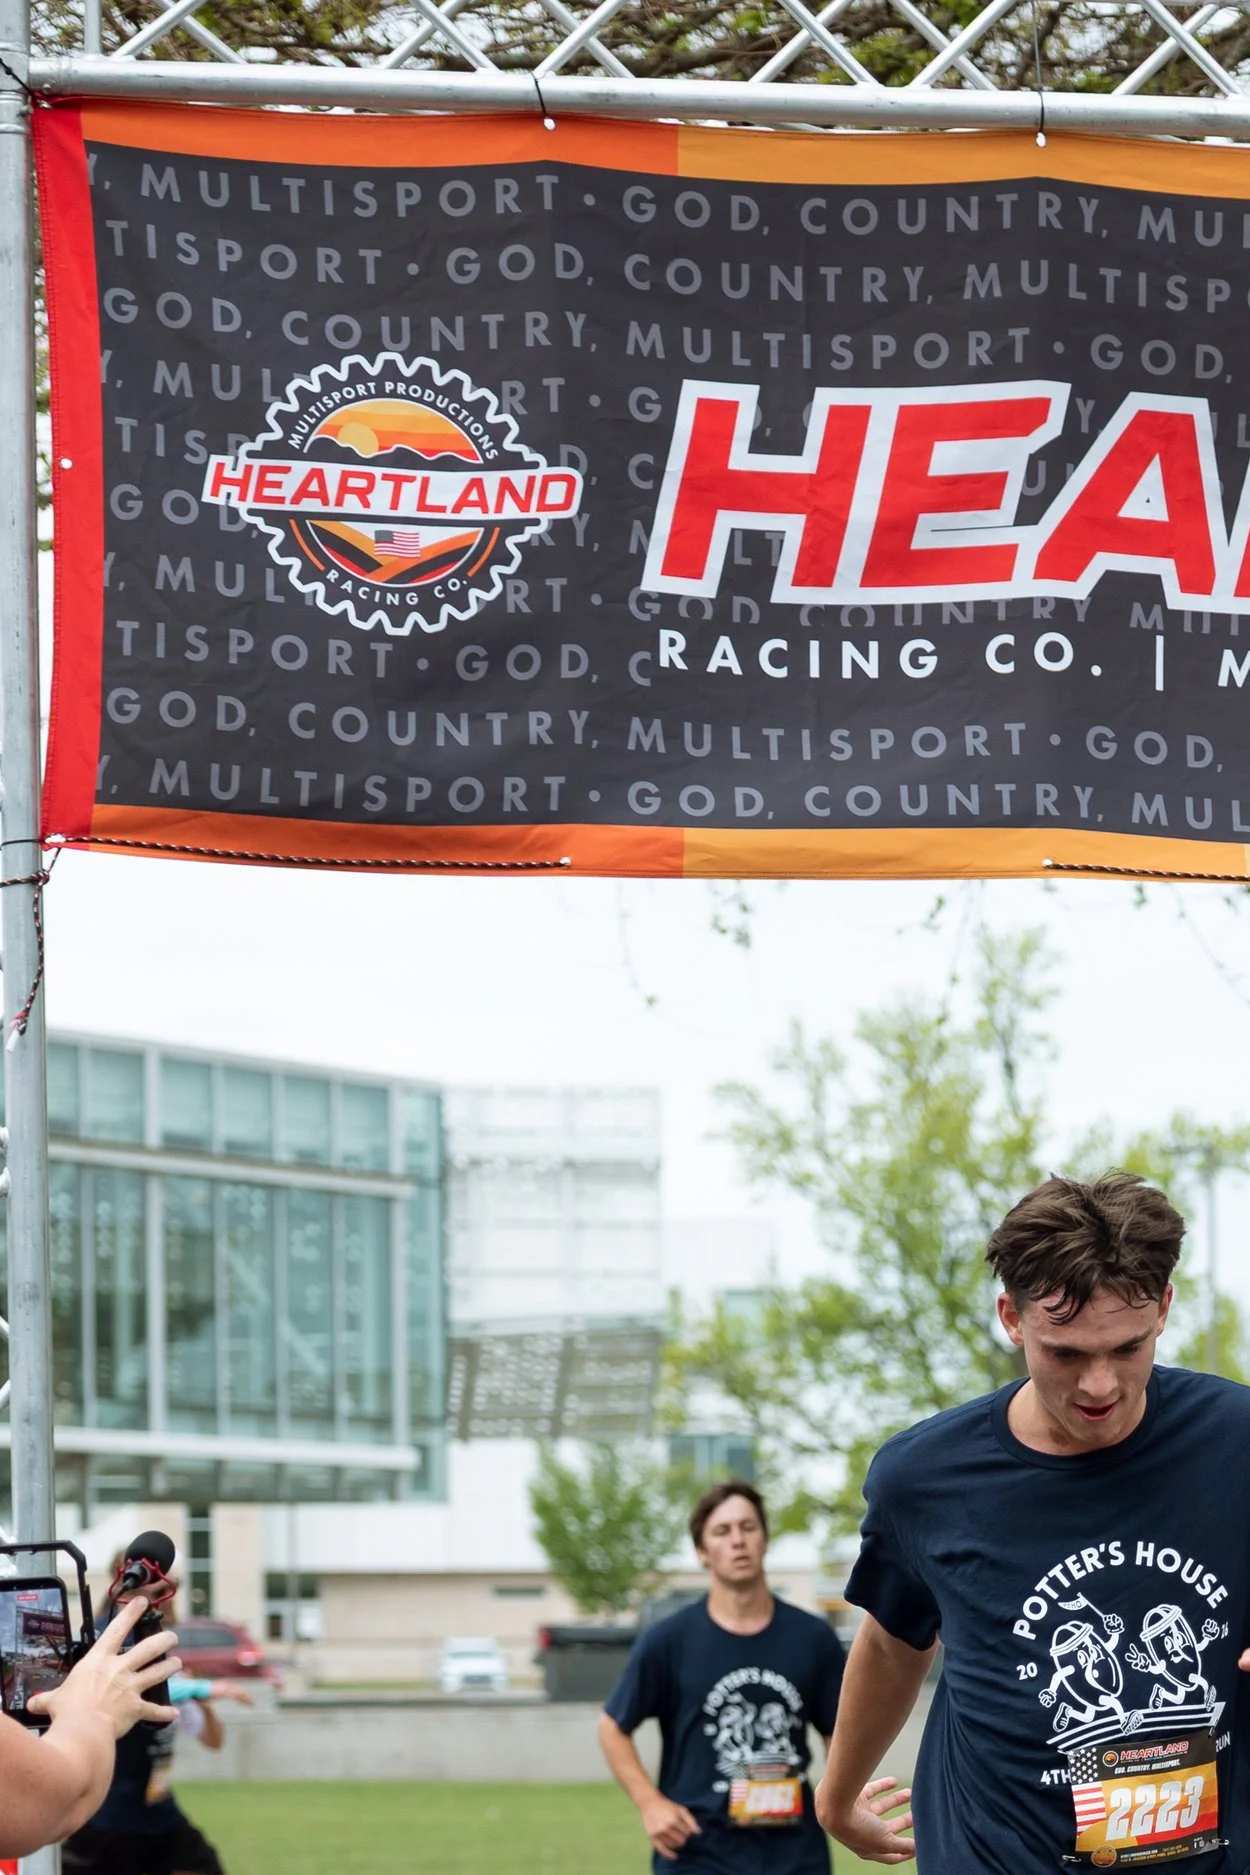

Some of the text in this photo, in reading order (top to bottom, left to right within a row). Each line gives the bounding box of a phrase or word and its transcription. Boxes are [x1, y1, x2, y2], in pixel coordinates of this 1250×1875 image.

[141, 164, 559, 217] MULTISPORT
[623, 186, 769, 235] GOD,
[800, 192, 1107, 239] COUNTRY,
[446, 243, 593, 286] GOD,
[624, 254, 933, 304] COUNTRY,
[104, 288, 252, 339] GOD,
[282, 311, 596, 352] COUNTRY,
[626, 321, 1030, 370] MULTISPORT
[1091, 334, 1231, 384] GOD,
[287, 381, 499, 460] MULTISPORT PRODUCTIONS
[207, 459, 579, 517] HEARTLAND
[326, 569, 467, 606] RACING CO.
[456, 644, 598, 683] GOD,
[658, 629, 938, 678] RACING
[985, 632, 1102, 676] CO.
[106, 687, 255, 736] GOD,
[289, 702, 598, 749] COUNTRY,
[627, 717, 1026, 761] MULTISPORT
[1086, 726, 1224, 773] GOD,
[149, 758, 566, 812] MULTISPORT
[627, 781, 773, 820] GOD,
[804, 783, 1103, 822] COUNTRY,
[1012, 1541, 1229, 1641] POTTER'S HOUSE
[1016, 1662, 1038, 1681] 20
[1040, 1769, 1071, 1786] 4TH
[1121, 1741, 1189, 1760] HEARTLAND
[1106, 1776, 1204, 1841] 2223
